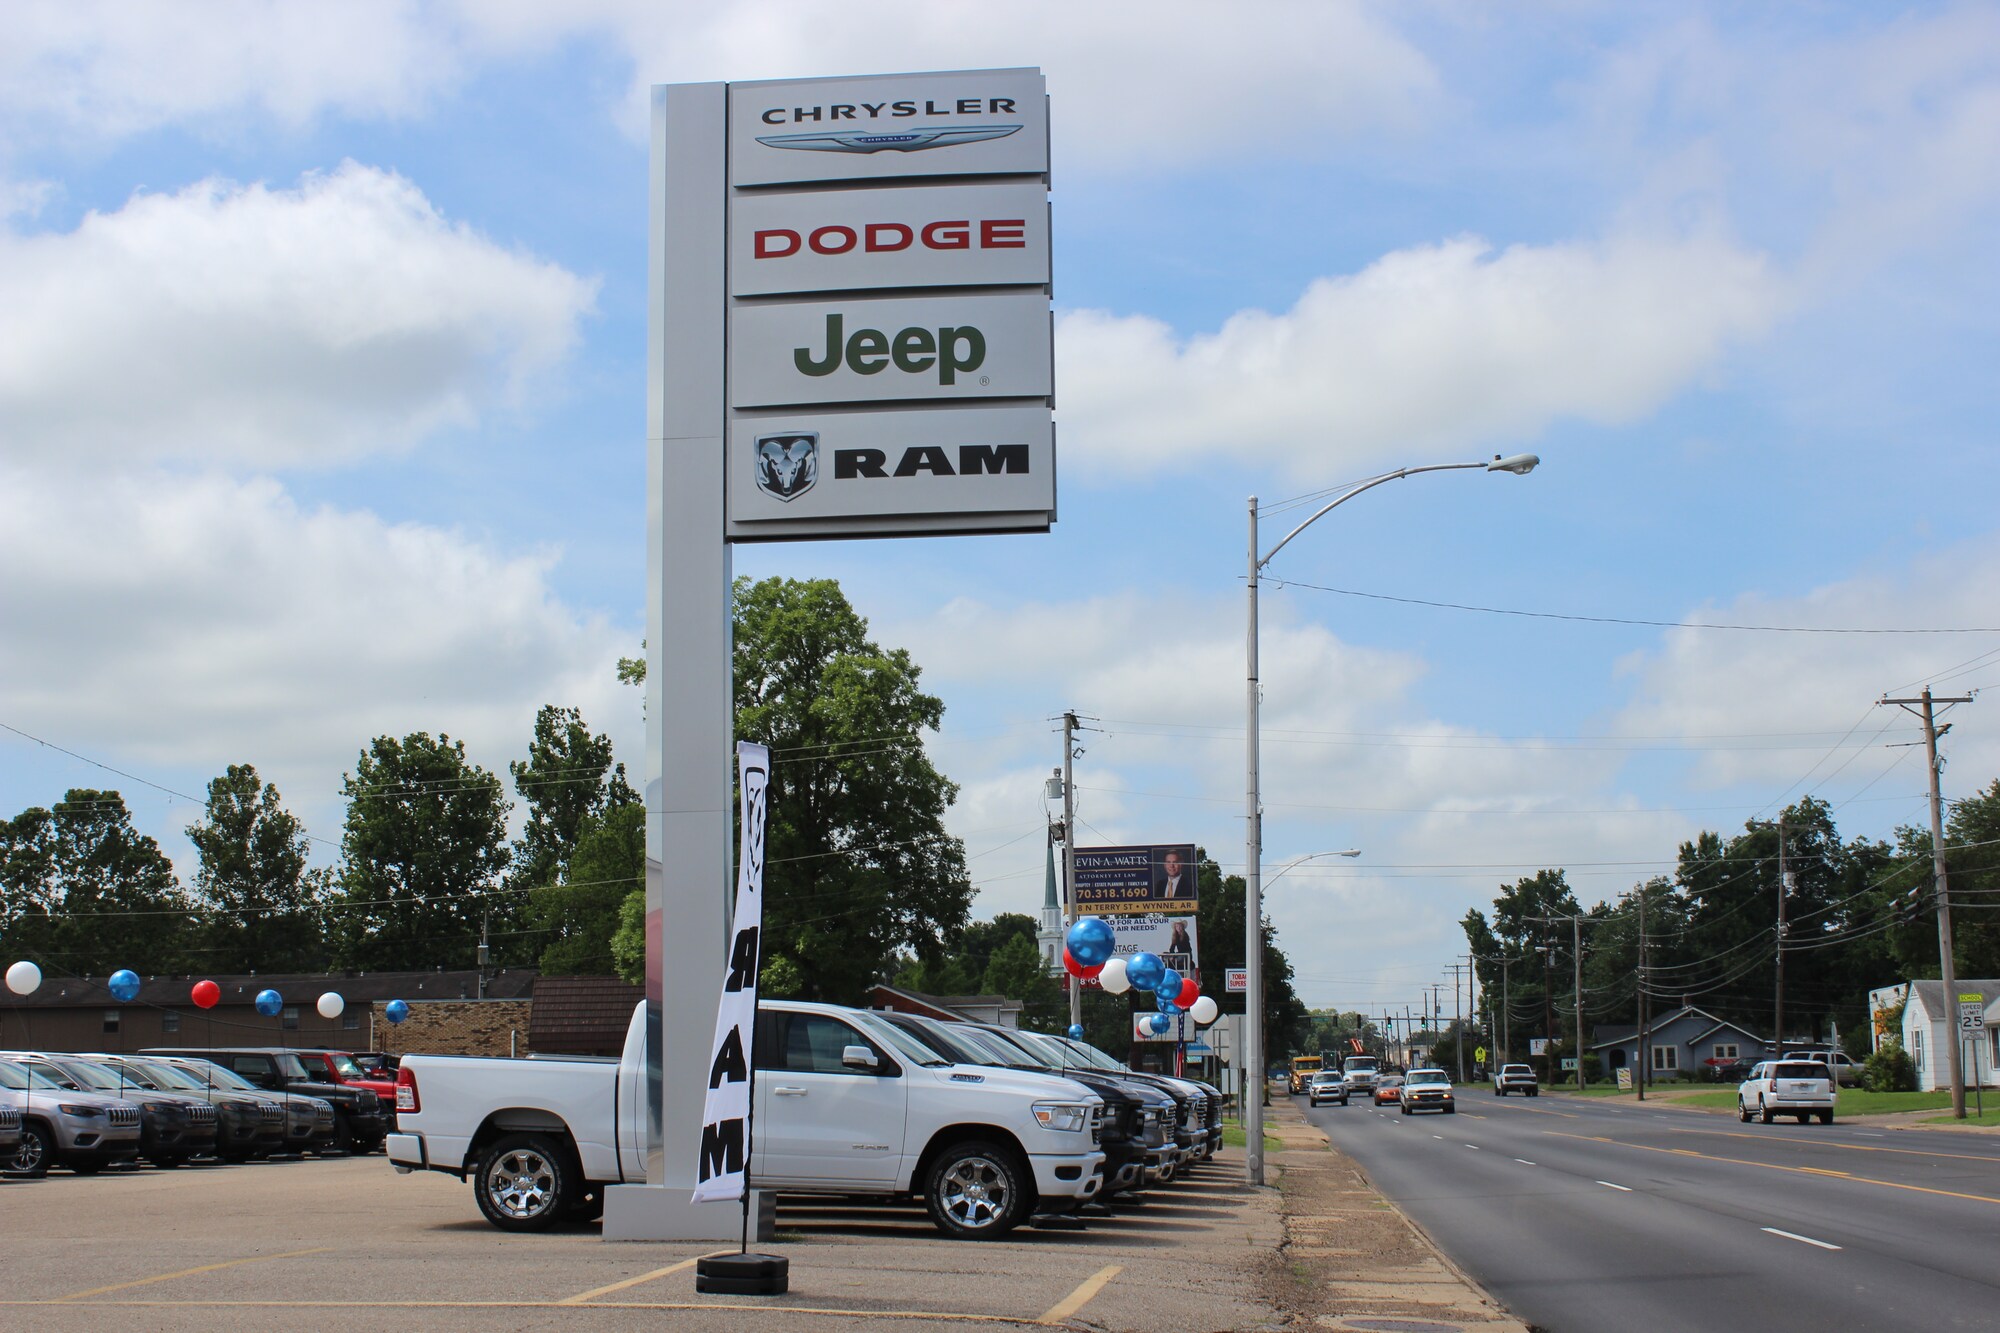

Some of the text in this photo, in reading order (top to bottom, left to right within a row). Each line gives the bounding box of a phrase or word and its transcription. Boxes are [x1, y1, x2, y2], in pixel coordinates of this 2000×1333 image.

[761, 98, 1017, 125] CHRYSLER
[754, 219, 1026, 260] DODGE
[793, 313, 987, 386] Jeep
[834, 443, 1030, 480] RAM
[1074, 857, 1100, 867] EVIN
[1115, 856, 1148, 866] WATTS
[1076, 888, 1148, 899] 70.318.1690
[1094, 903, 1120, 911] TERRY
[1142, 902, 1177, 910] WYNNE,
[1113, 944, 1138, 953] NTAGE
[1963, 1016, 1982, 1027] 25
